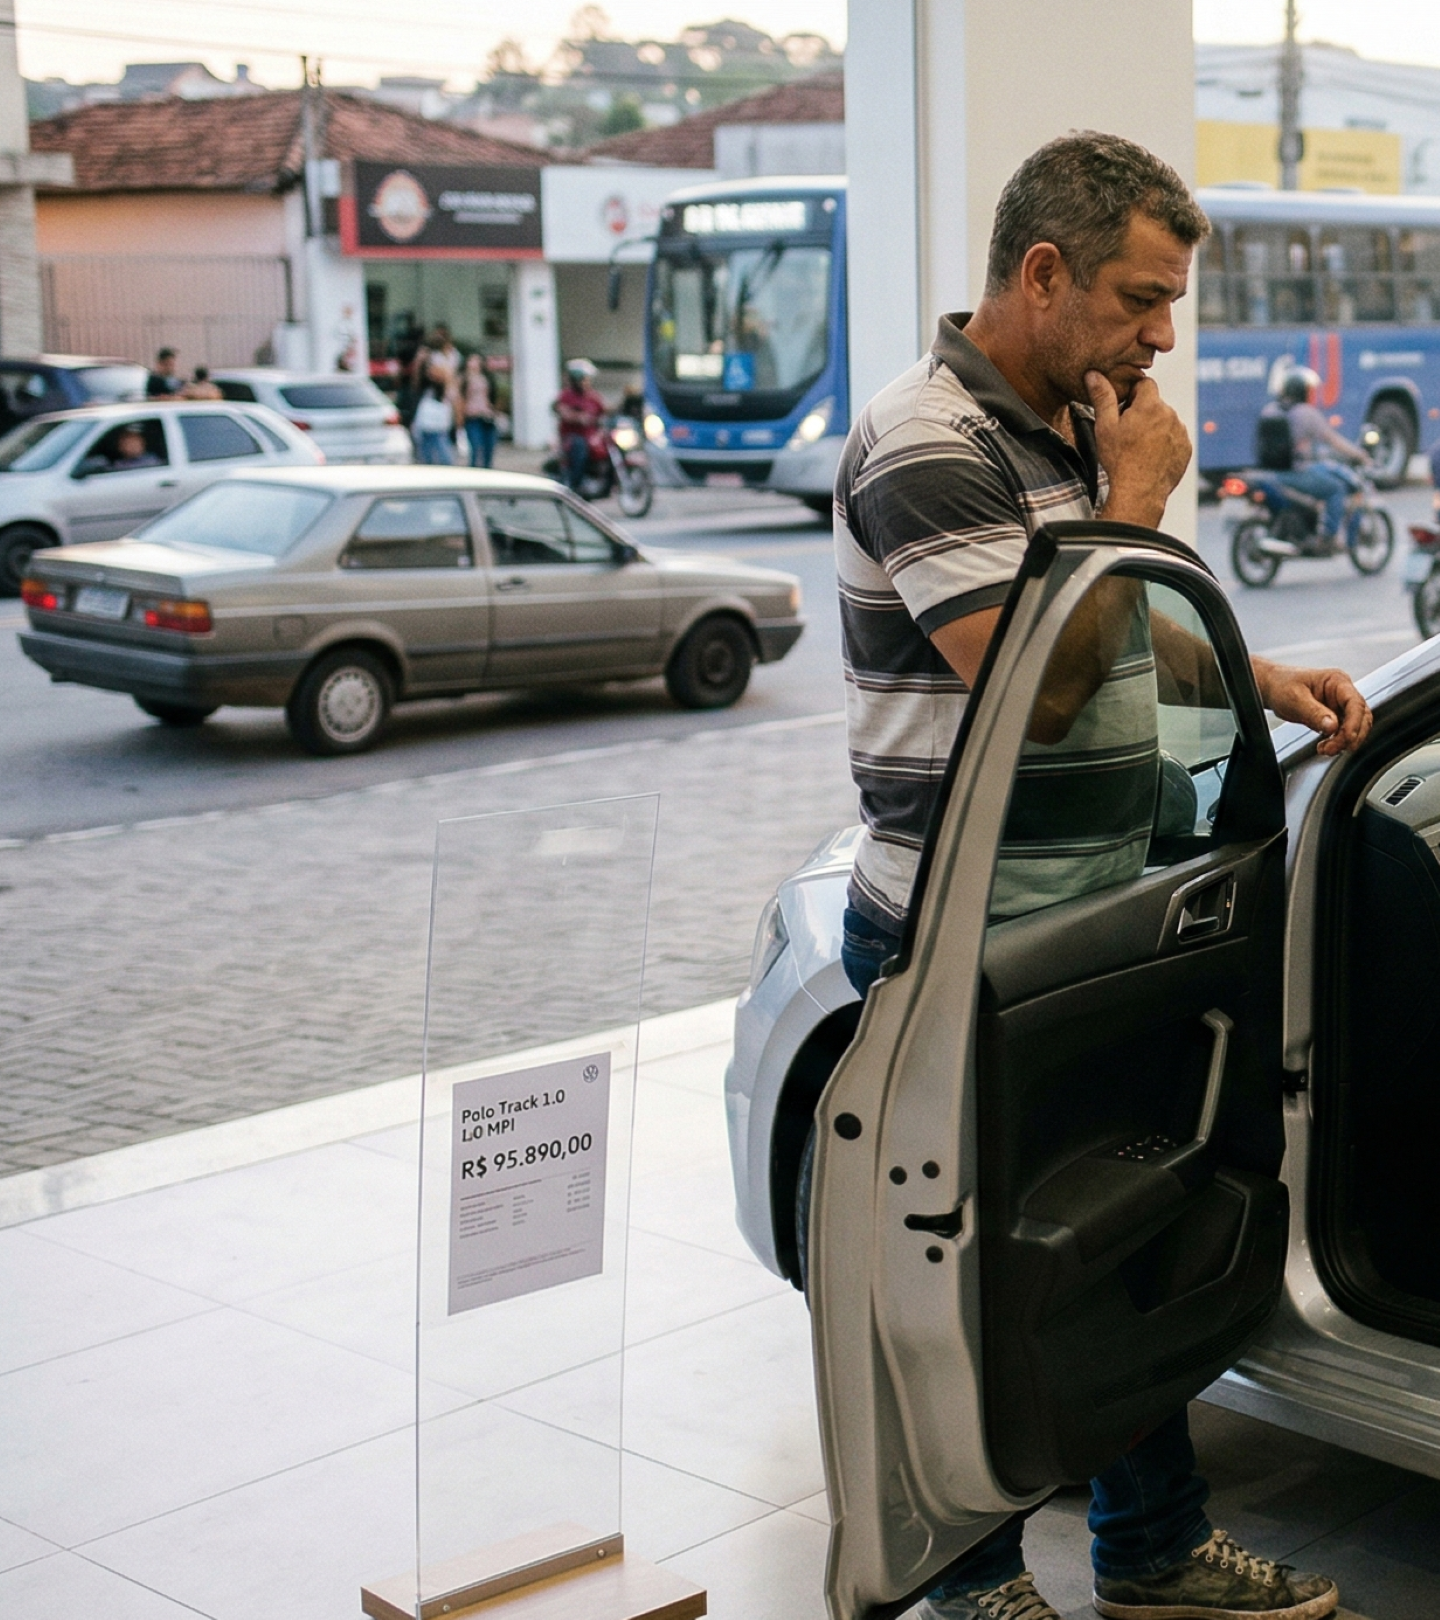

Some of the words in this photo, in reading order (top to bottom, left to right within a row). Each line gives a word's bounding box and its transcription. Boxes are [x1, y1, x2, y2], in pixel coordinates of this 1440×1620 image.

[461, 1106, 495, 1124] Polo
[499, 1095, 538, 1115] Track
[543, 1089, 565, 1107] 1.0
[487, 1118, 515, 1136] MPI
[461, 1156, 487, 1180] R$
[493, 1133, 592, 1172] 95.890,00
